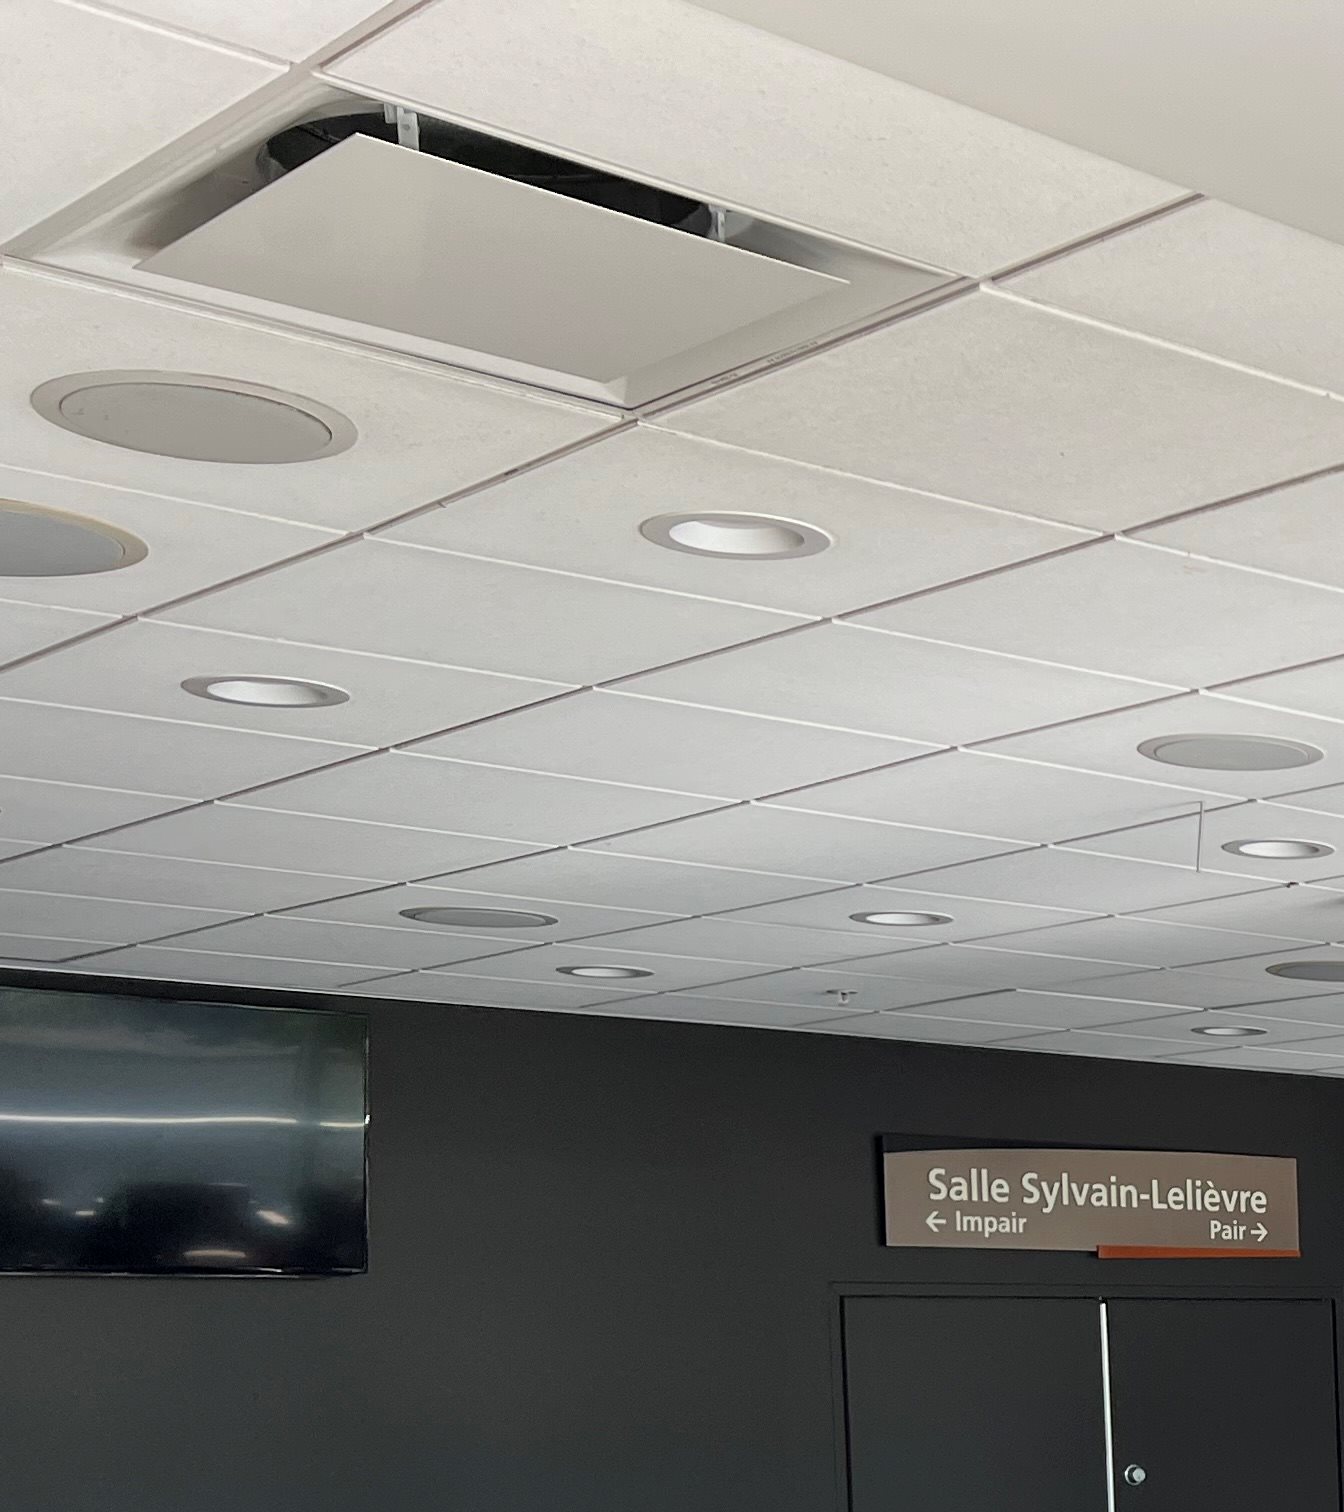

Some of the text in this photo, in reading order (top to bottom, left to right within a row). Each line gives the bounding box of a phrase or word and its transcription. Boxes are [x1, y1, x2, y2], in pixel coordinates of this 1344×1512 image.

[927, 1167, 1268, 1214] Salle Sylvain-Lelièvre
[955, 1210, 1027, 1238] Impair
[1210, 1220, 1246, 1241] Pair
